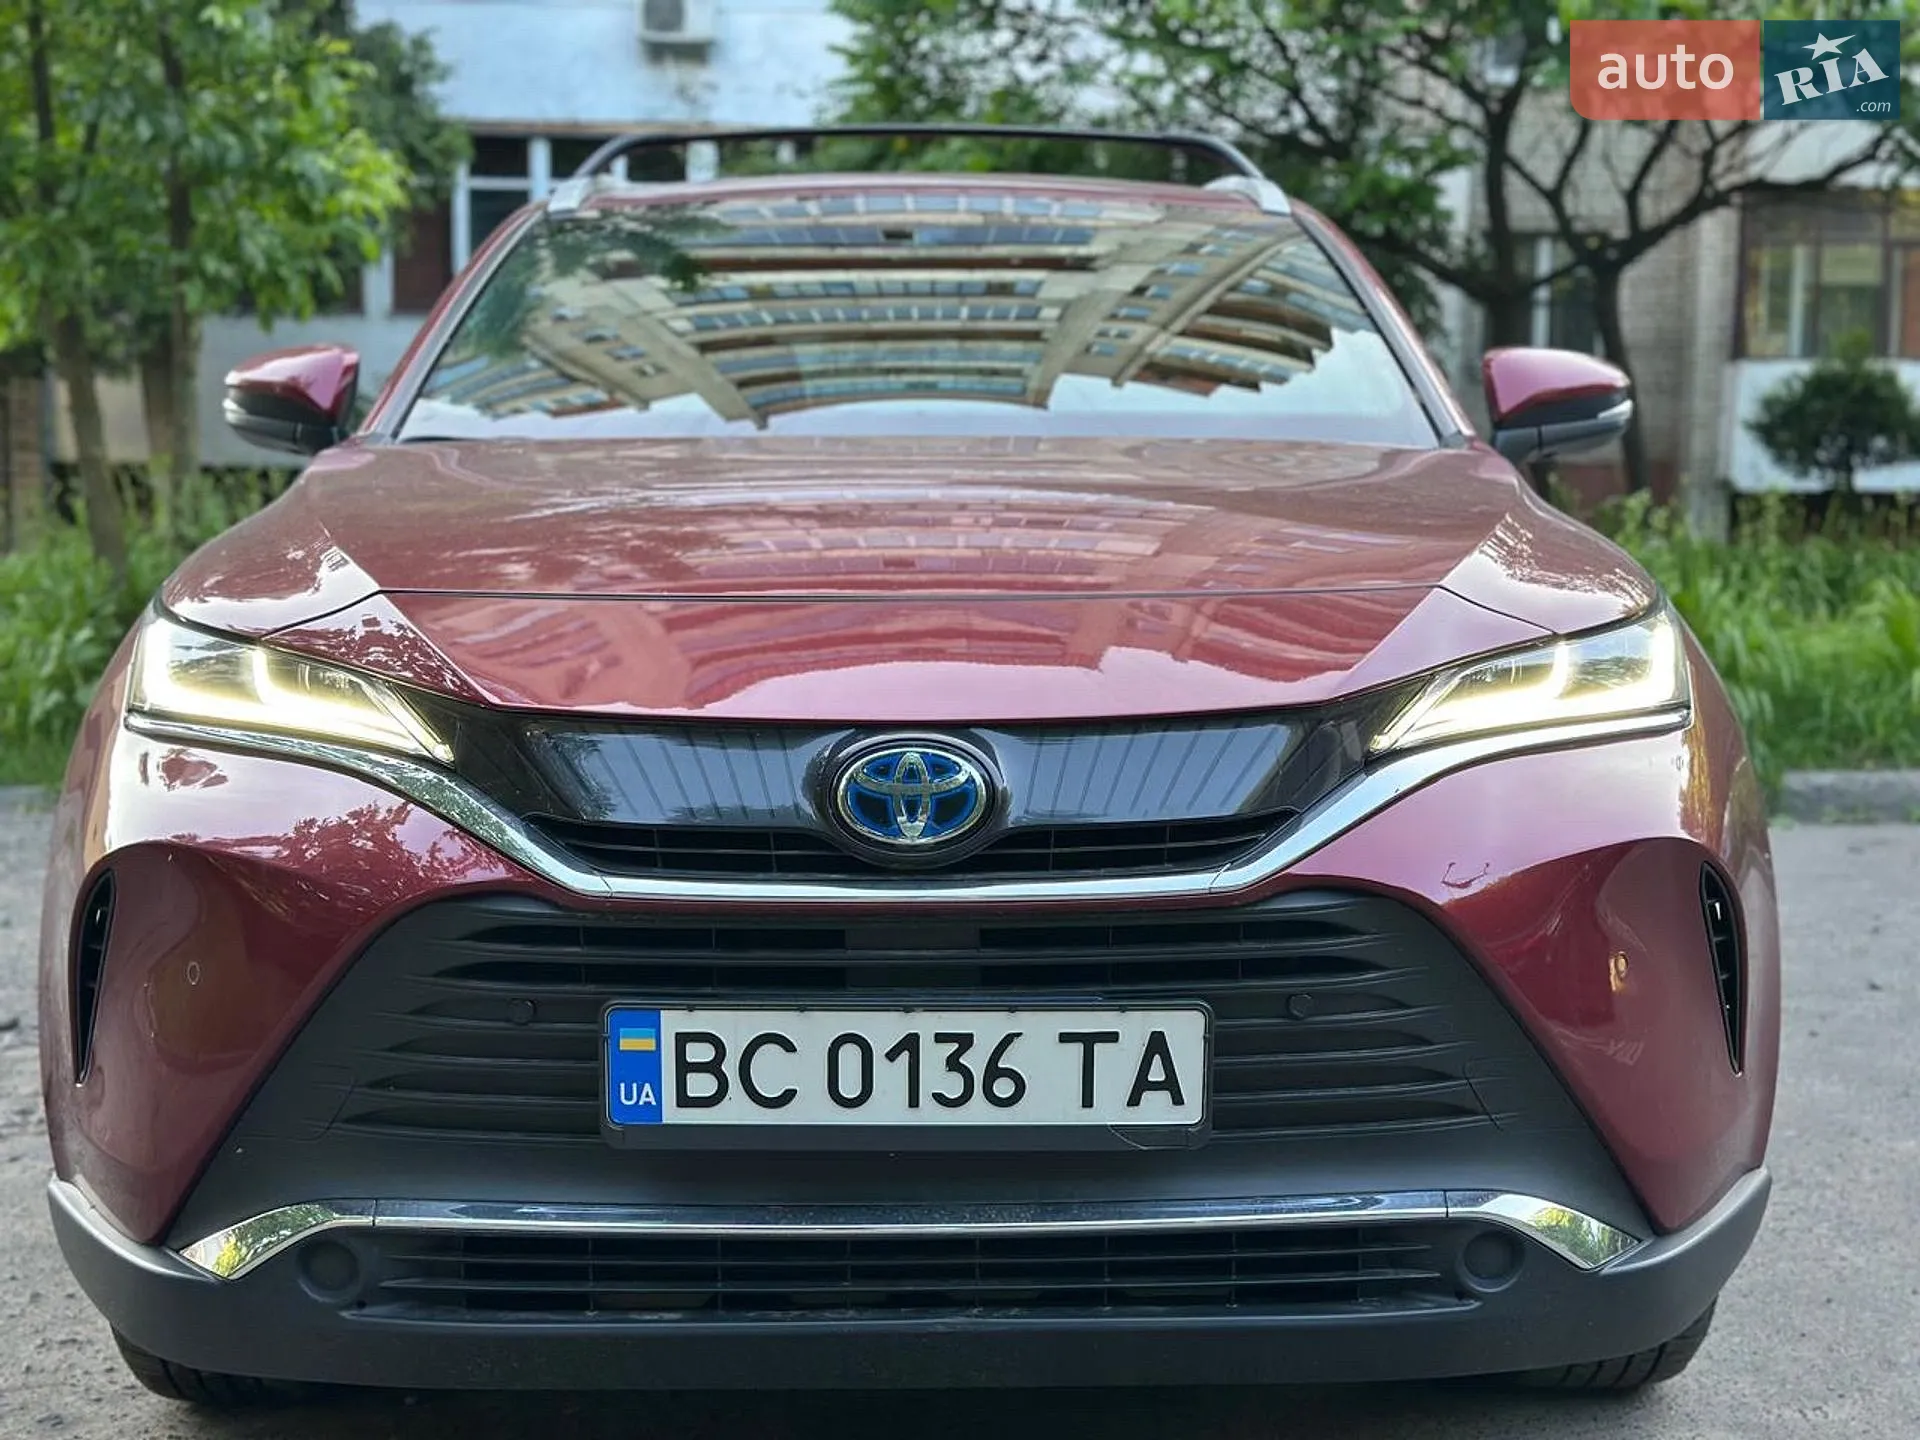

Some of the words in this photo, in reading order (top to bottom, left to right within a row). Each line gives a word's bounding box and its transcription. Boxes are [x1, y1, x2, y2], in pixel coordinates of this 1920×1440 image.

[619, 1083, 657, 1107] UA
[674, 1031, 798, 1109] BC
[827, 1031, 1027, 1109] 0136
[1058, 1030, 1186, 1108] TA
